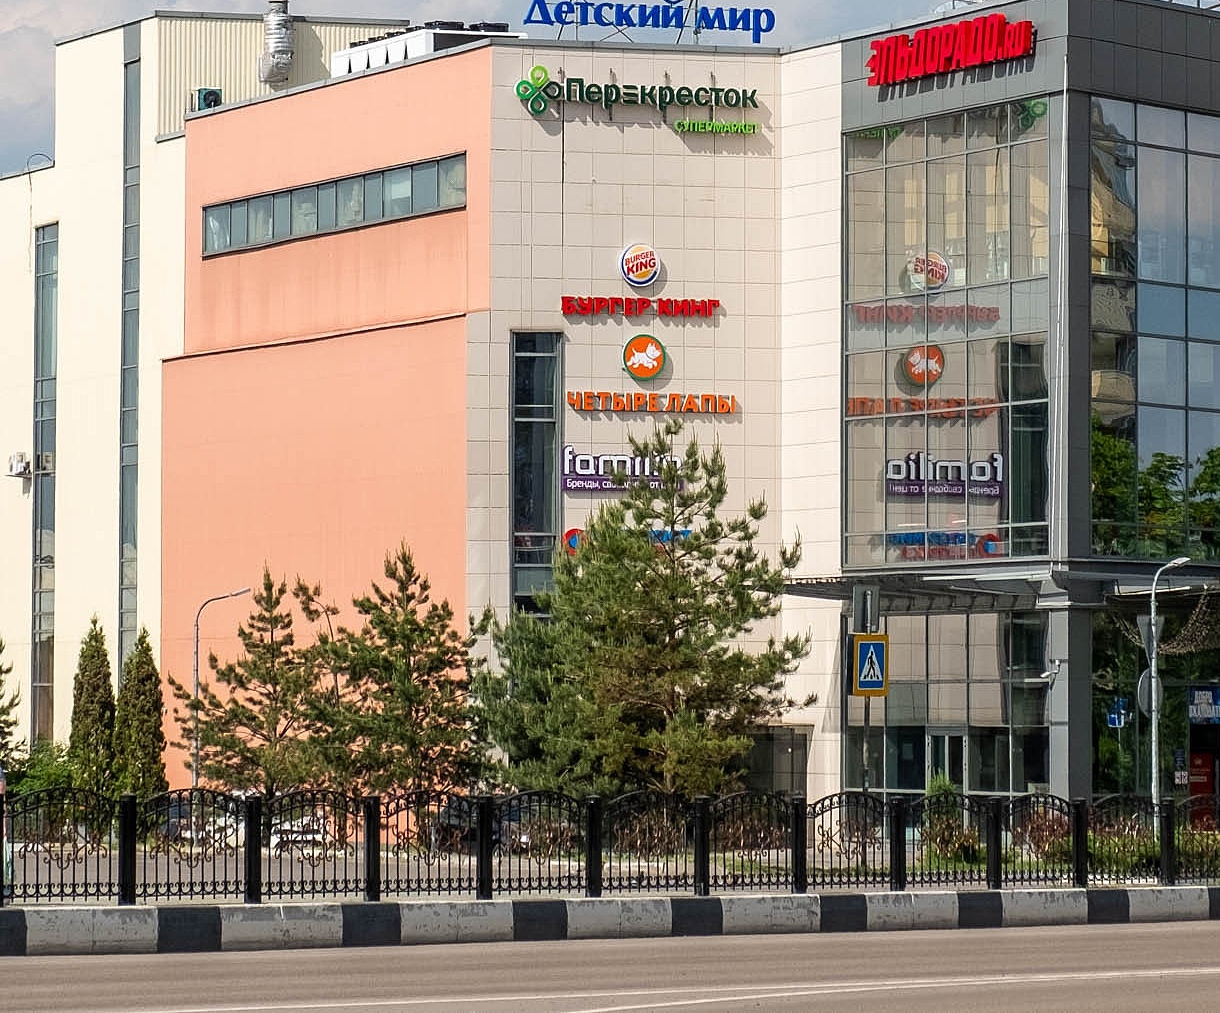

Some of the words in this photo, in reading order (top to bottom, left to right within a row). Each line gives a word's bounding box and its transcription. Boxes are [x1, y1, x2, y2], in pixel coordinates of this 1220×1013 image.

[696, 6, 775, 44] мир
[674, 120, 759, 134] СУПЕРМАРКЕТ
[624, 250, 655, 266] BURGER
[626, 257, 657, 275] KING
[561, 296, 651, 316] БУРГЕР
[657, 298, 720, 317] КИНГ
[567, 391, 660, 412] ЧЕТЫРЕ
[665, 394, 735, 414] ЛАПЫ
[563, 446, 682, 476] famil
